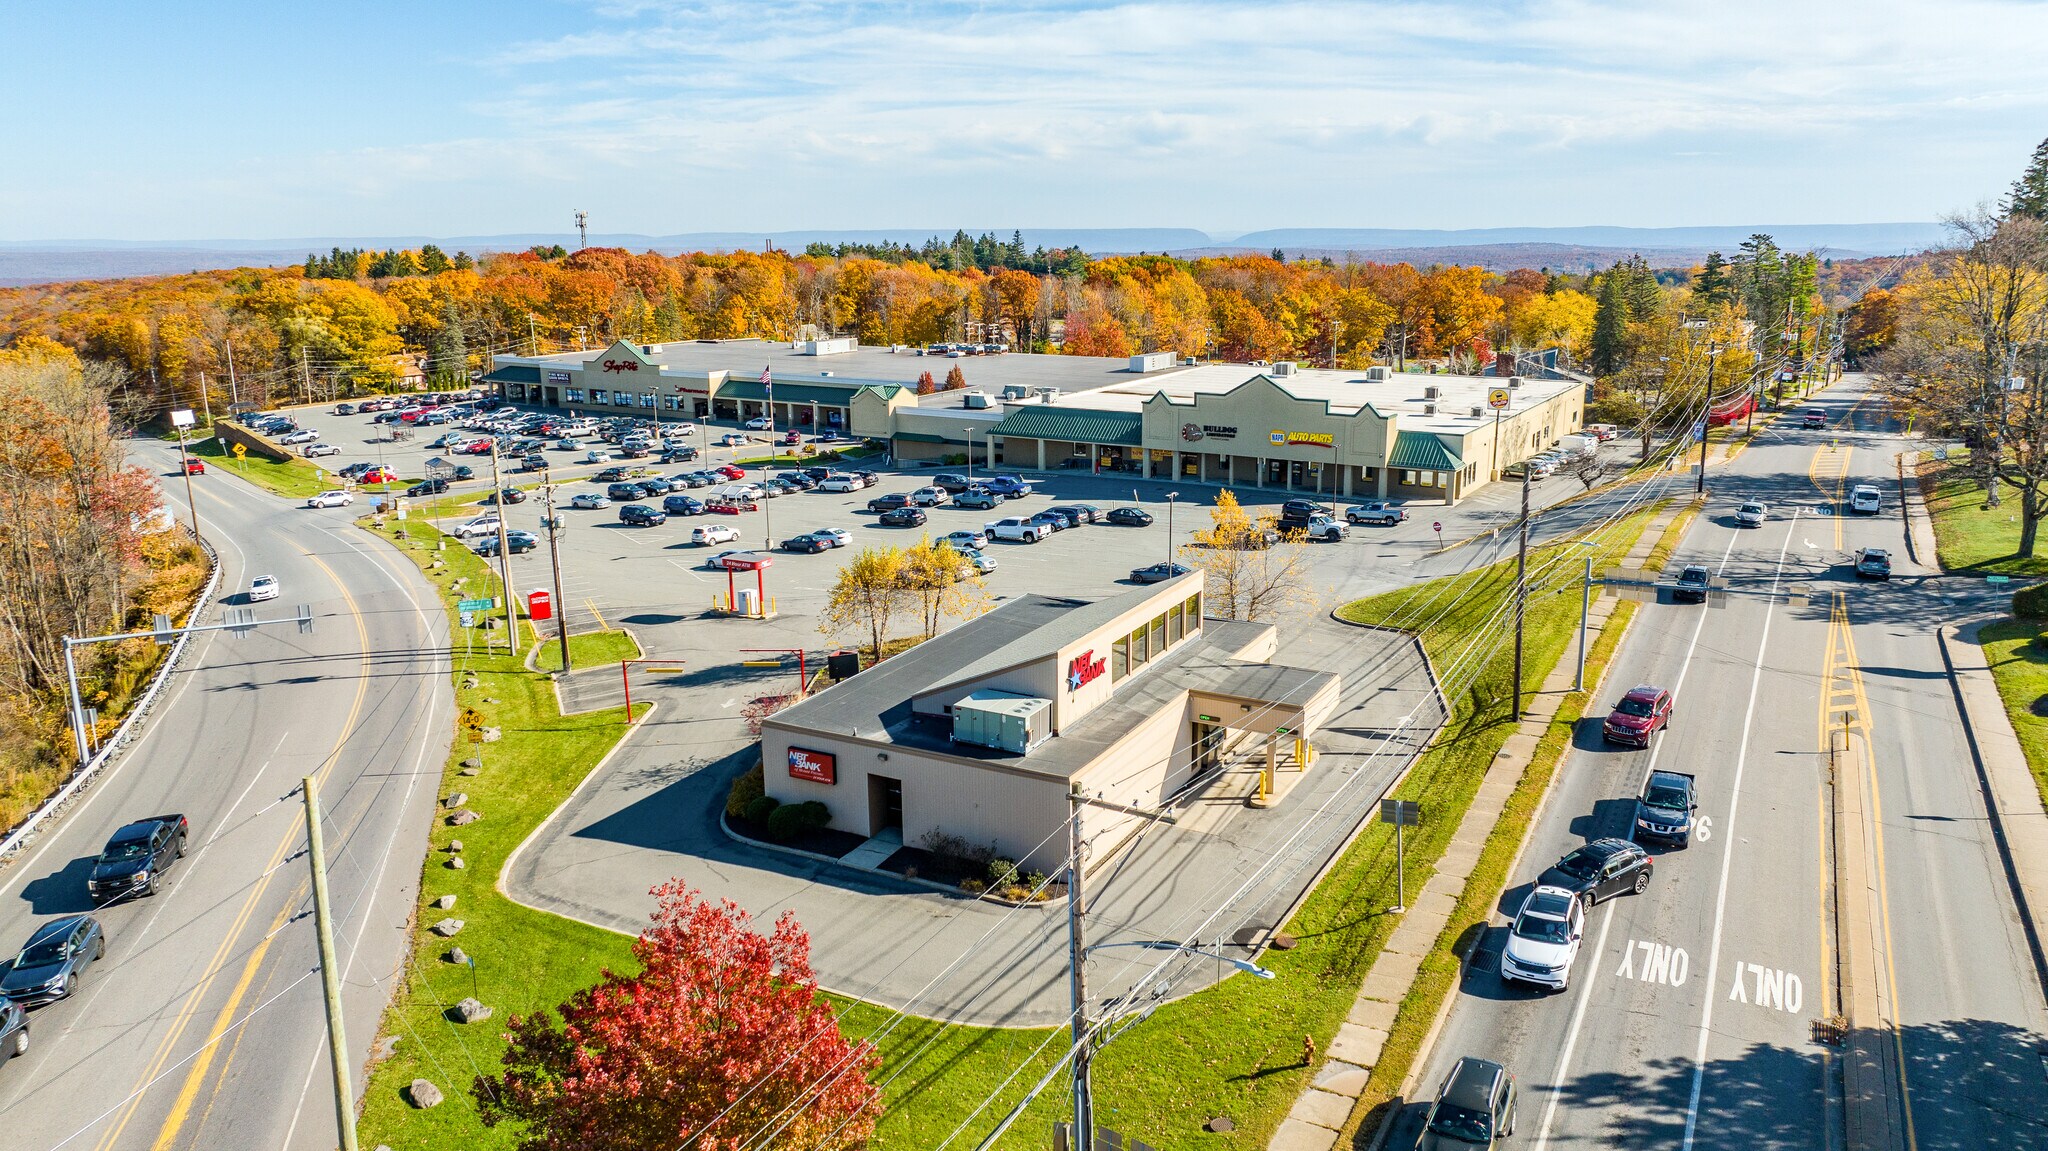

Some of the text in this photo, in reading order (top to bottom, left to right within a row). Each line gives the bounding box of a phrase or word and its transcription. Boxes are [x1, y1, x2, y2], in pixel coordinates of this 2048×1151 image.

[602, 359, 639, 375] ShopRite
[679, 387, 709, 395] Pharmacy
[1203, 425, 1237, 433] BULLDOG
[1271, 431, 1333, 444] NAPA AUTO PARTS
[789, 751, 809, 761] NBT
[795, 760, 822, 772] BANK
[1615, 939, 1690, 988] ONLY
[1729, 961, 1803, 1015] ONLY
